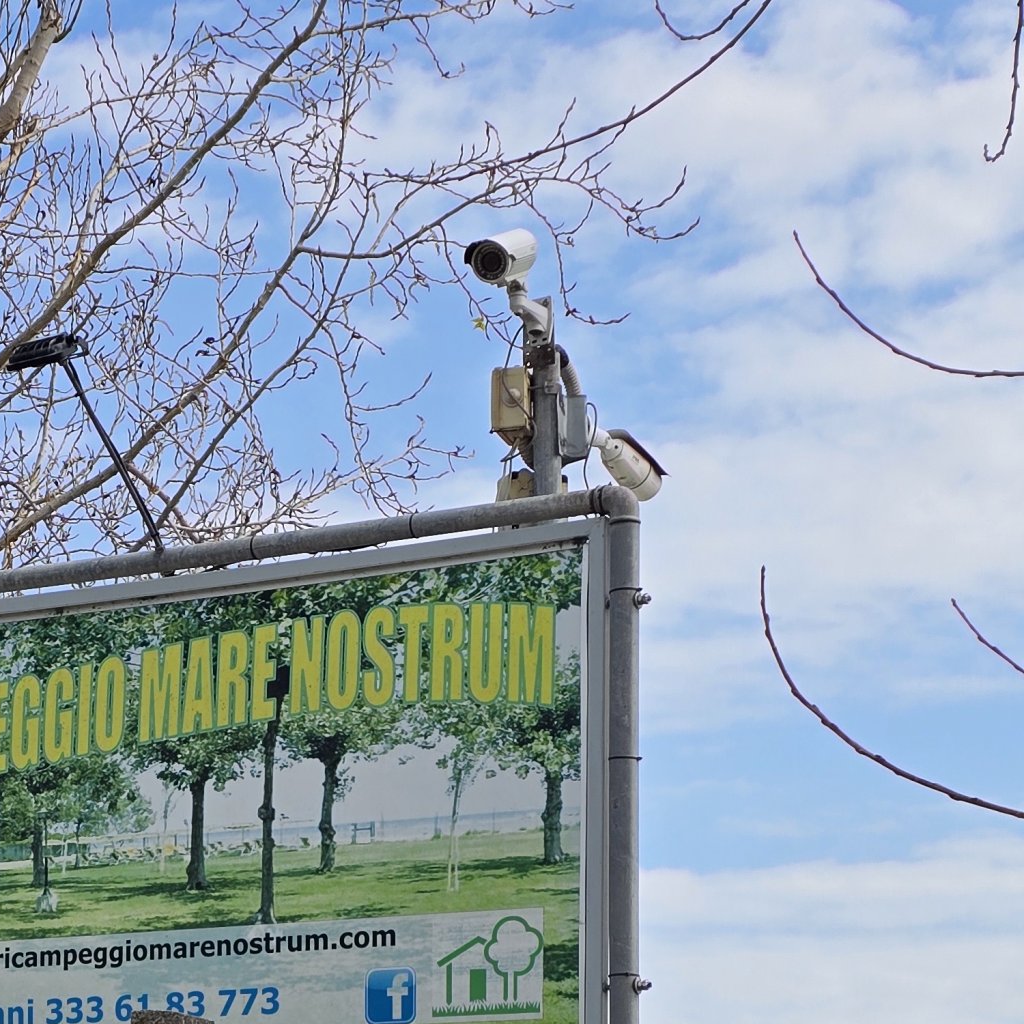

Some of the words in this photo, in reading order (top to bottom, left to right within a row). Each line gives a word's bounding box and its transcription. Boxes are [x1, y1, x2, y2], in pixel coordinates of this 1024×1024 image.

[137, 622, 278, 745] MARE
[288, 601, 556, 718] NOSTRUM
[45, 996, 104, 1024] 333
[114, 993, 149, 1022] 61
[166, 991, 205, 1016] 83
[217, 987, 280, 1017] 773
